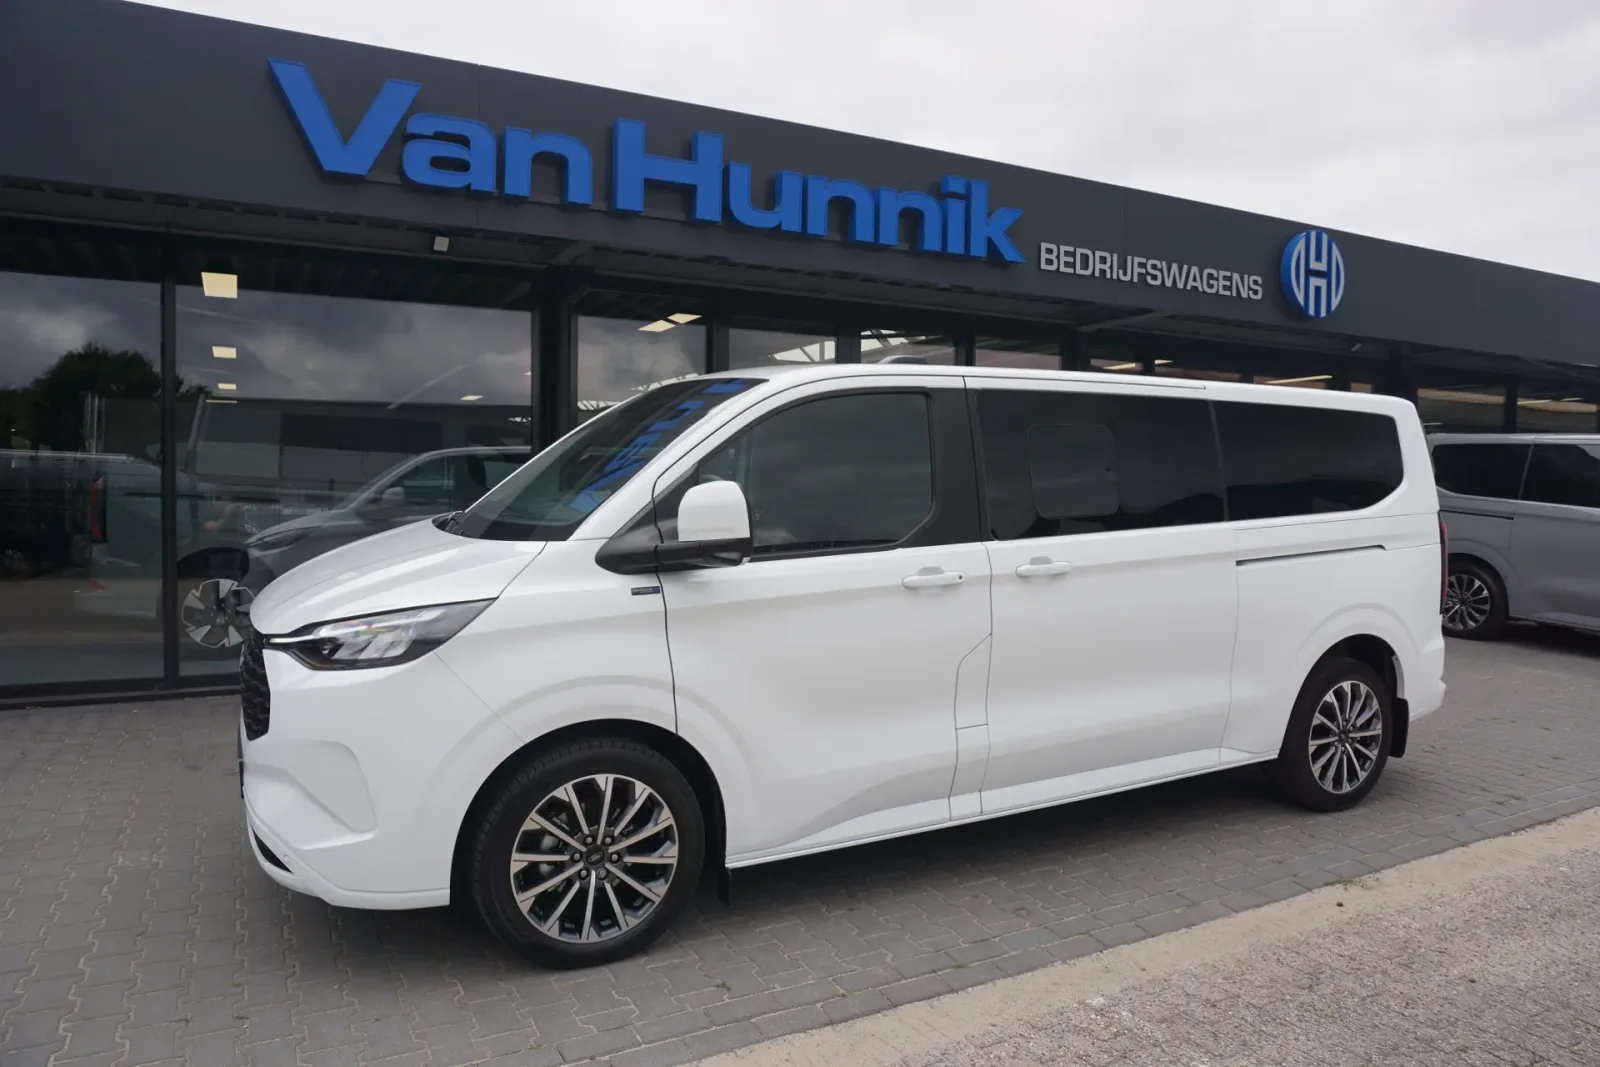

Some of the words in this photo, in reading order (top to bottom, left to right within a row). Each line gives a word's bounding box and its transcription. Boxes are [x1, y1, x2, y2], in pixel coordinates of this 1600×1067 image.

[267, 57, 594, 207] Van
[611, 117, 1025, 265] Hunnik
[1039, 241, 1263, 300] BEDRIJFSWAGENS
